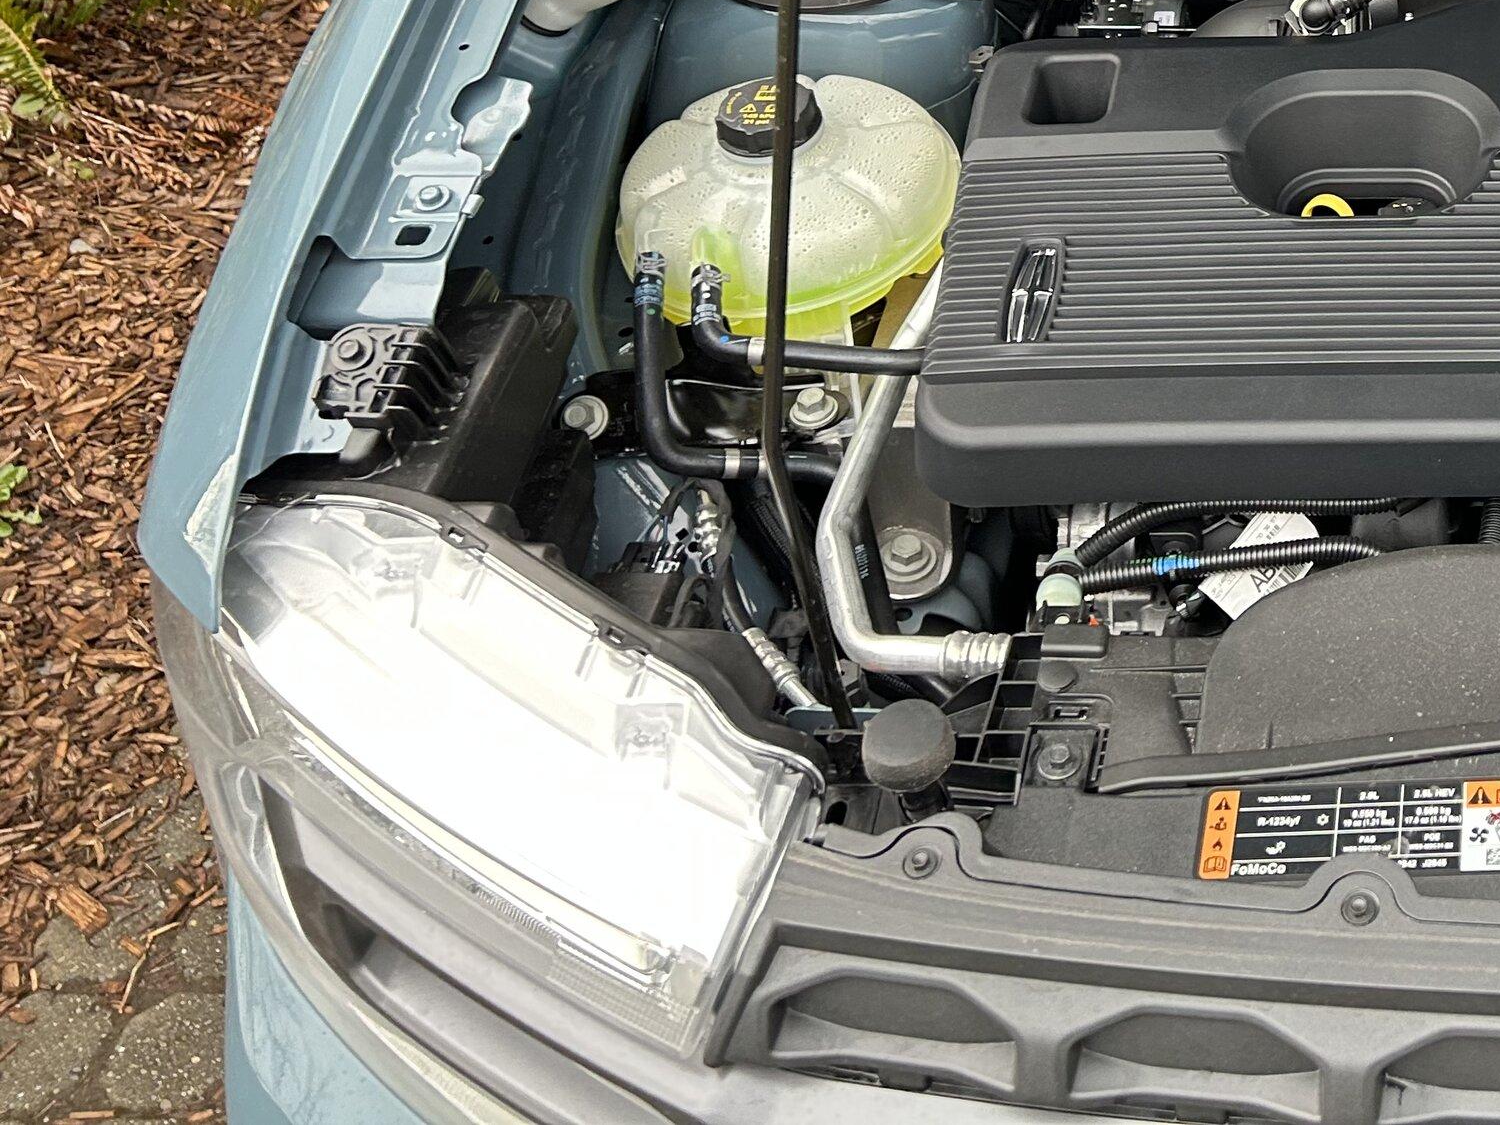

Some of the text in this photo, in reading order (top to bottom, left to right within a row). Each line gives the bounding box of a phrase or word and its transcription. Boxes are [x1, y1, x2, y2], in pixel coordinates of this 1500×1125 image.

[1434, 787, 1456, 798] HEV
[1256, 815, 1301, 828] R-1234yf
[1230, 862, 1287, 876] FoMoCo
